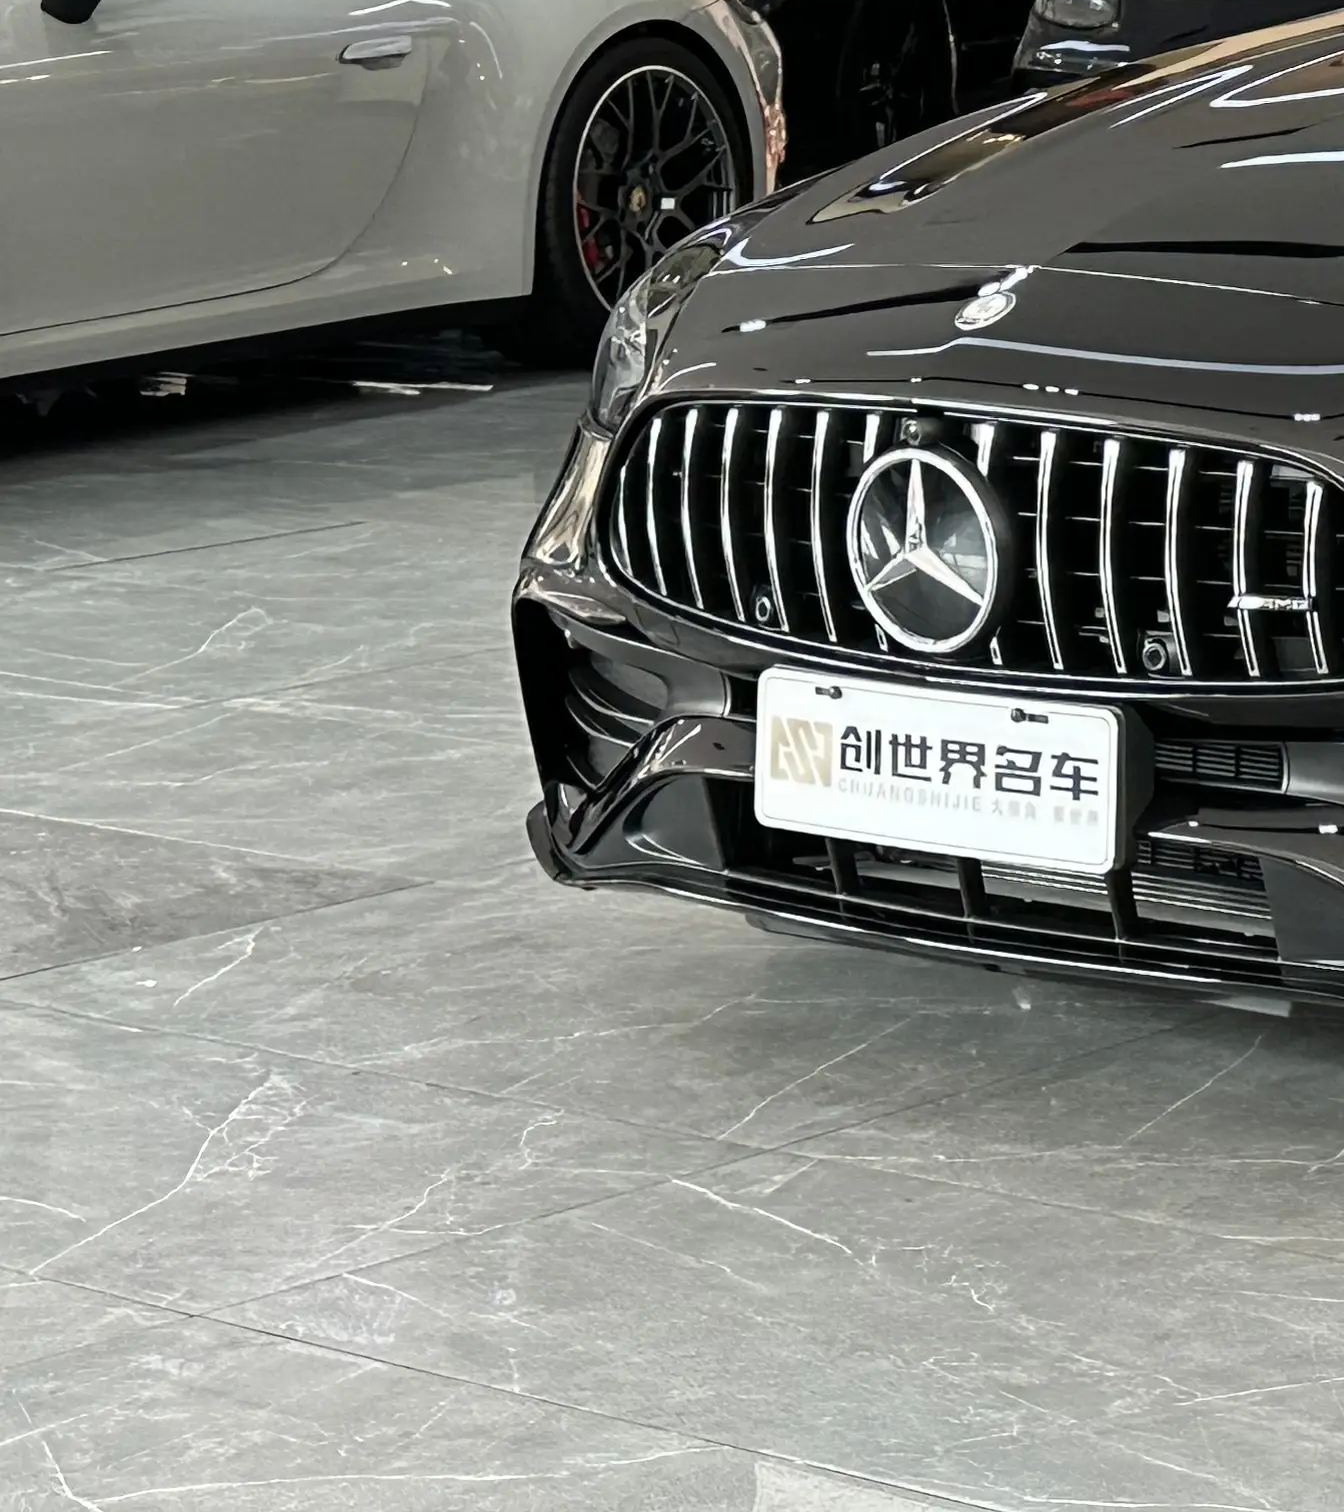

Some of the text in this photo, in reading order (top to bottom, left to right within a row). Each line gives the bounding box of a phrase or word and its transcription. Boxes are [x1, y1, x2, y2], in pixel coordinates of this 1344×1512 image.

[840, 725, 1099, 801] 创世界名车
